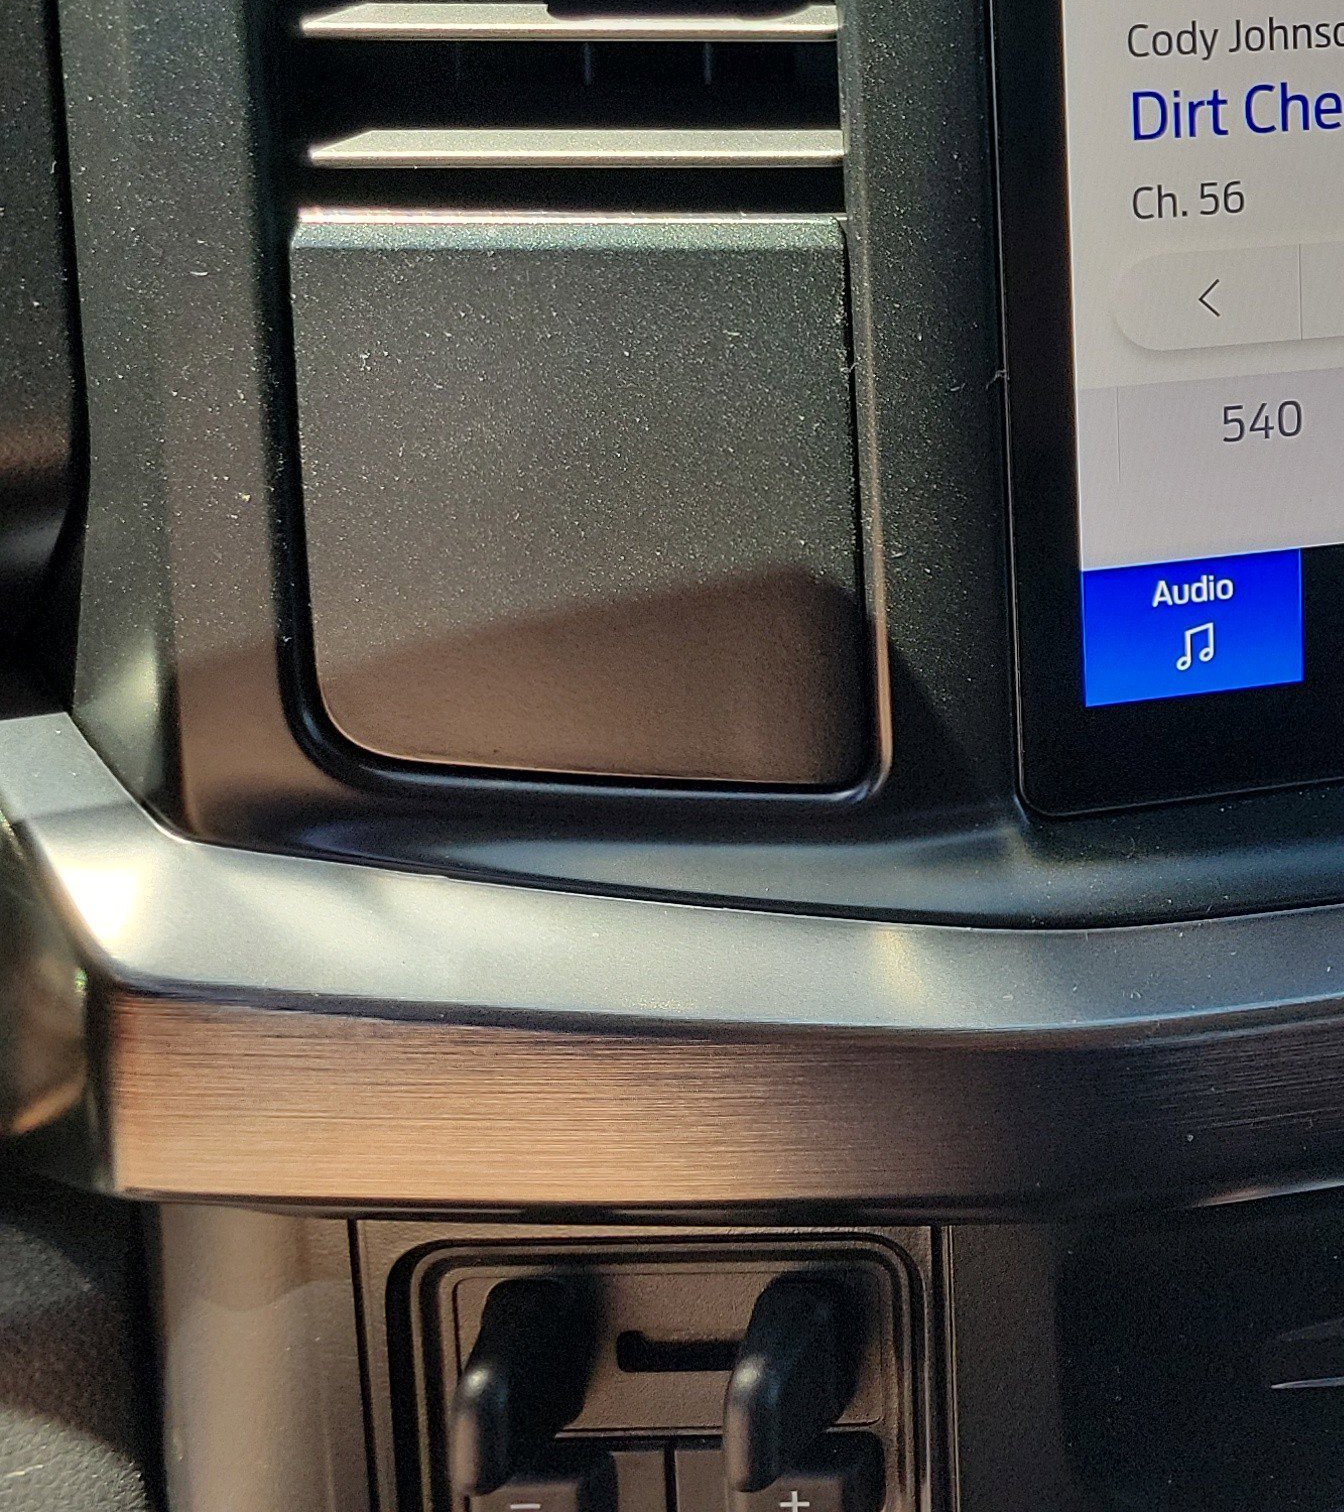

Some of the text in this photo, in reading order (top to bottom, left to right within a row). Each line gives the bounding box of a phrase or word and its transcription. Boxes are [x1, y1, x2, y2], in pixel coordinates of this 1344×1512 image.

[1127, 21, 1219, 61] Cody
[1132, 88, 1229, 140] Dirt
[1132, 180, 1245, 219] Ch. 56
[1222, 400, 1303, 443] 540
[1152, 573, 1234, 608] Audio
